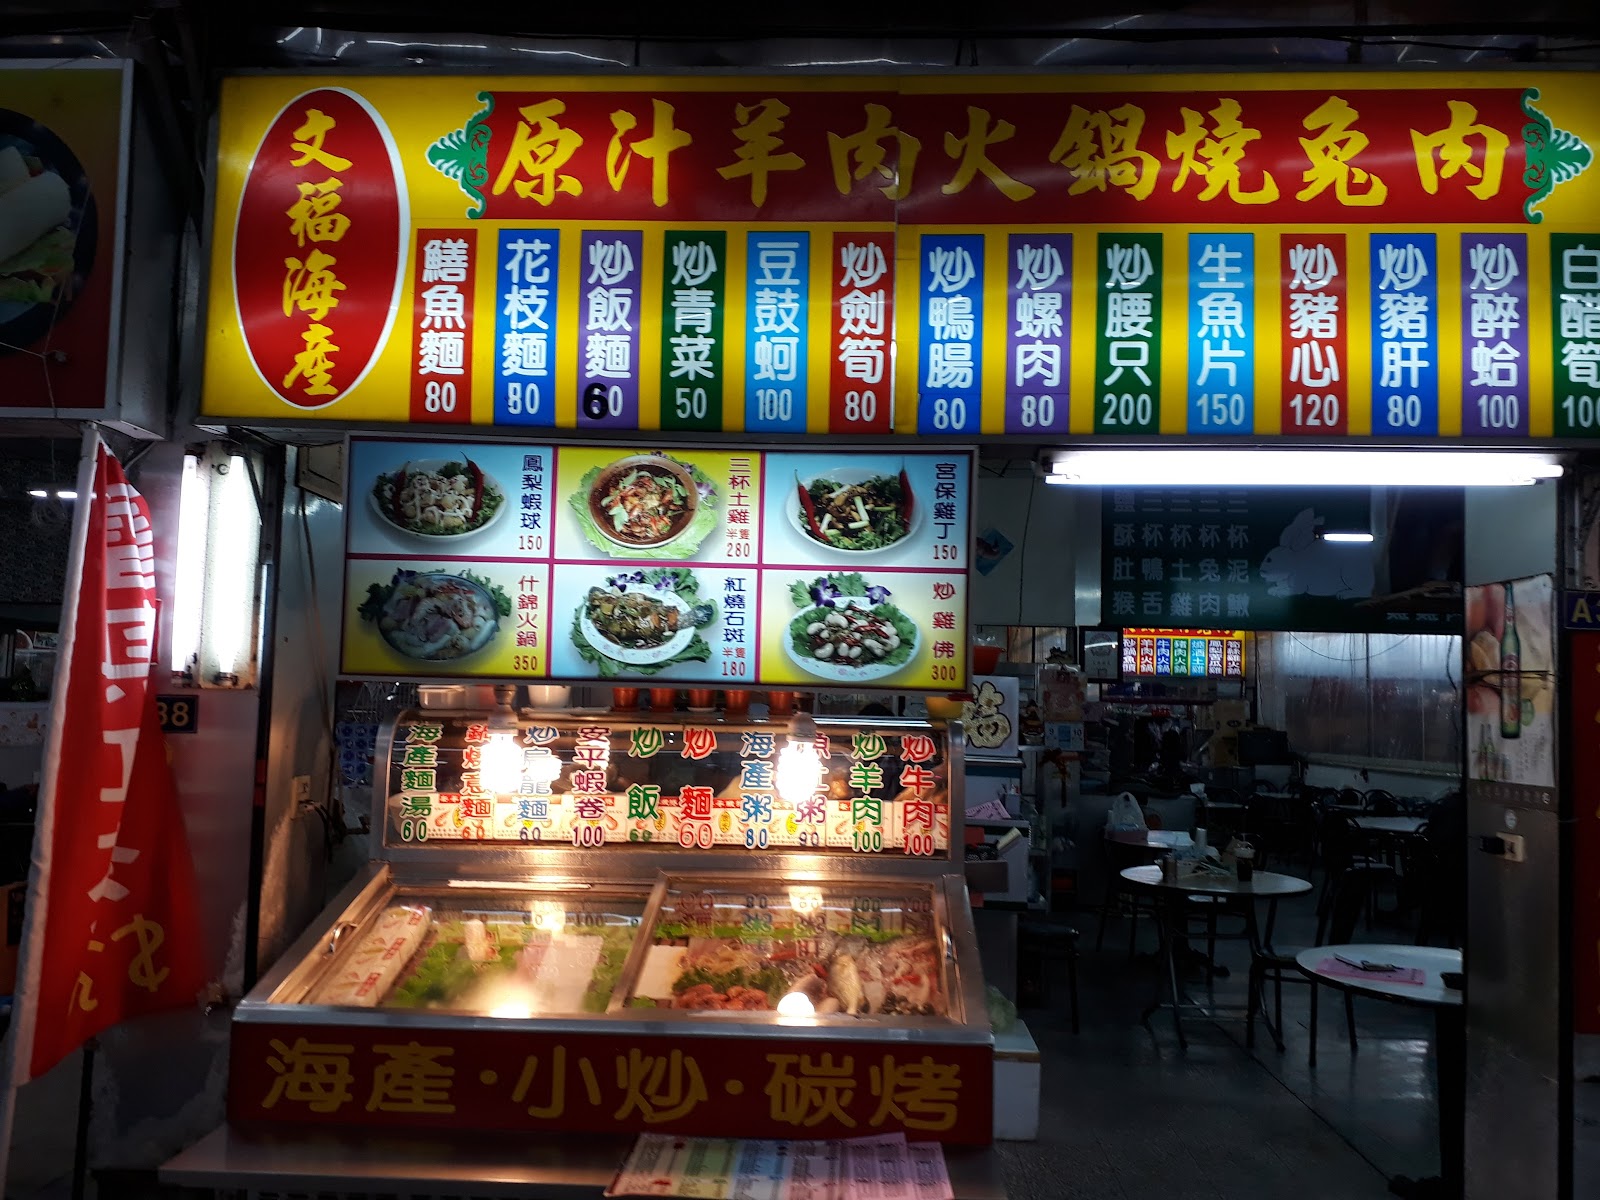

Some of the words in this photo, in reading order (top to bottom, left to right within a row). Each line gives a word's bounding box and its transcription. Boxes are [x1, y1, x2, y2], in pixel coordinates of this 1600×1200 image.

[492, 96, 1510, 208] 原汁羊肉火鍋燒兔肉
[282, 108, 354, 396] 文福海產
[419, 238, 470, 376] 鱔魚麵
[501, 238, 552, 378] 花枝麵
[584, 238, 634, 380] 炒飯麵
[669, 239, 718, 381] 炒青菜
[926, 245, 976, 390] 炒鴨腸
[1014, 242, 1064, 388] 炒螺肉
[1102, 242, 1155, 388] 炒腰只
[1196, 242, 1246, 388] 生魚片
[1288, 243, 1340, 389] 炒豬心
[1378, 243, 1430, 390] 炒豬肝
[1469, 243, 1521, 390] 炒醉蛤
[424, 381, 457, 414] 80
[582, 382, 624, 421] 60
[675, 386, 707, 420] 50
[756, 388, 793, 422] 100
[844, 390, 877, 422] 80
[932, 397, 966, 431] 80
[1020, 394, 1055, 429] 80
[1101, 393, 1152, 426] 200
[1196, 393, 1246, 427] 150
[1289, 394, 1340, 428] 120
[1386, 394, 1422, 428] 80
[1476, 394, 1520, 430] 100
[1562, 394, 1600, 428] 10
[519, 453, 544, 531] 鳳梨蝦球
[727, 457, 752, 525] 三杯土雞
[933, 462, 958, 540] 宮保雞丁
[517, 534, 543, 551] 150
[726, 542, 751, 558] 280
[932, 544, 958, 561] 150
[516, 575, 541, 648] 什錦火鍋
[723, 576, 747, 644] 紅燒石斑
[932, 581, 957, 660] 炒雞佛
[513, 654, 538, 672] 350
[721, 660, 746, 677] 180
[931, 665, 957, 682] 300
[400, 724, 443, 818] 海產麵湯
[572, 726, 611, 820] 安平蝦卷
[740, 730, 776, 823] 海產粥
[850, 732, 886, 827] 炒羊肉
[900, 735, 936, 830] 炒牛肉
[402, 820, 429, 841] 60
[572, 826, 604, 847] 100
[678, 823, 713, 848] 60
[745, 828, 770, 848] 80
[852, 831, 881, 852] 100
[903, 834, 934, 855] 100
